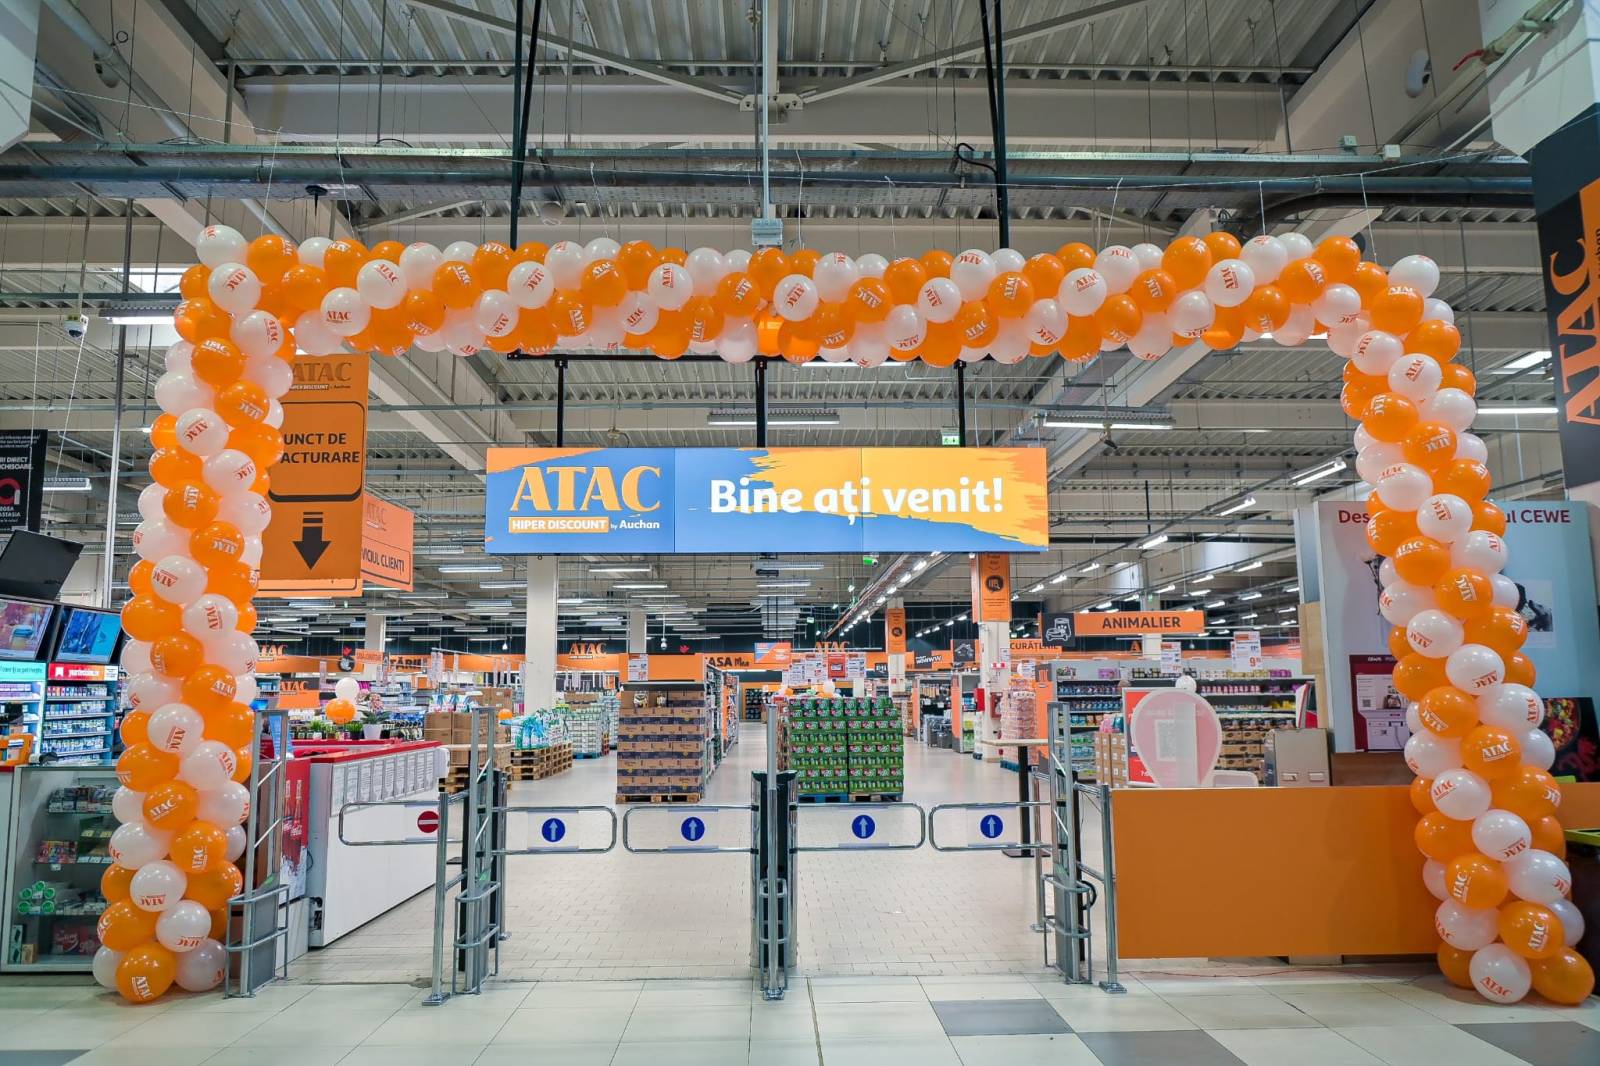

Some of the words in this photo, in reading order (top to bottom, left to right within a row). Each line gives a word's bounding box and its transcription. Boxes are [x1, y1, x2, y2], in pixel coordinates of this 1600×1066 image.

[326, 310, 352, 321] ATAC
[292, 361, 353, 382] ATAC
[186, 422, 208, 442] ATAC
[283, 432, 324, 445] UNCT
[328, 432, 347, 445] DE
[280, 451, 361, 464] ACTURARE
[510, 465, 662, 512] ATAC
[709, 476, 803, 514] Bine
[814, 476, 872, 526] ați
[882, 476, 1004, 514] venit!
[1338, 509, 1370, 524] Des
[1520, 509, 1571, 523] CEWE
[512, 519, 546, 531] HIPER
[547, 519, 607, 531] DISCOUNT
[610, 523, 618, 531] by
[619, 519, 661, 530] Auchan
[361, 547, 380, 566] VICIUL
[380, 554, 405, 575] CLIENȚI
[1102, 616, 1181, 629] ANIMALIER
[259, 644, 288, 657] TAC
[568, 642, 607, 655] ATAC
[815, 641, 849, 654] ATAC
[705, 657, 734, 668] ASA
[280, 680, 309, 691] ATAC
[1474, 674, 1498, 689] ATAC
[1482, 740, 1513, 759] ATAC
[150, 798, 176, 817] ATAC
[1454, 871, 1468, 898] ATAC
[1529, 923, 1546, 950] ATAC
[1482, 976, 1513, 997] ATAC
